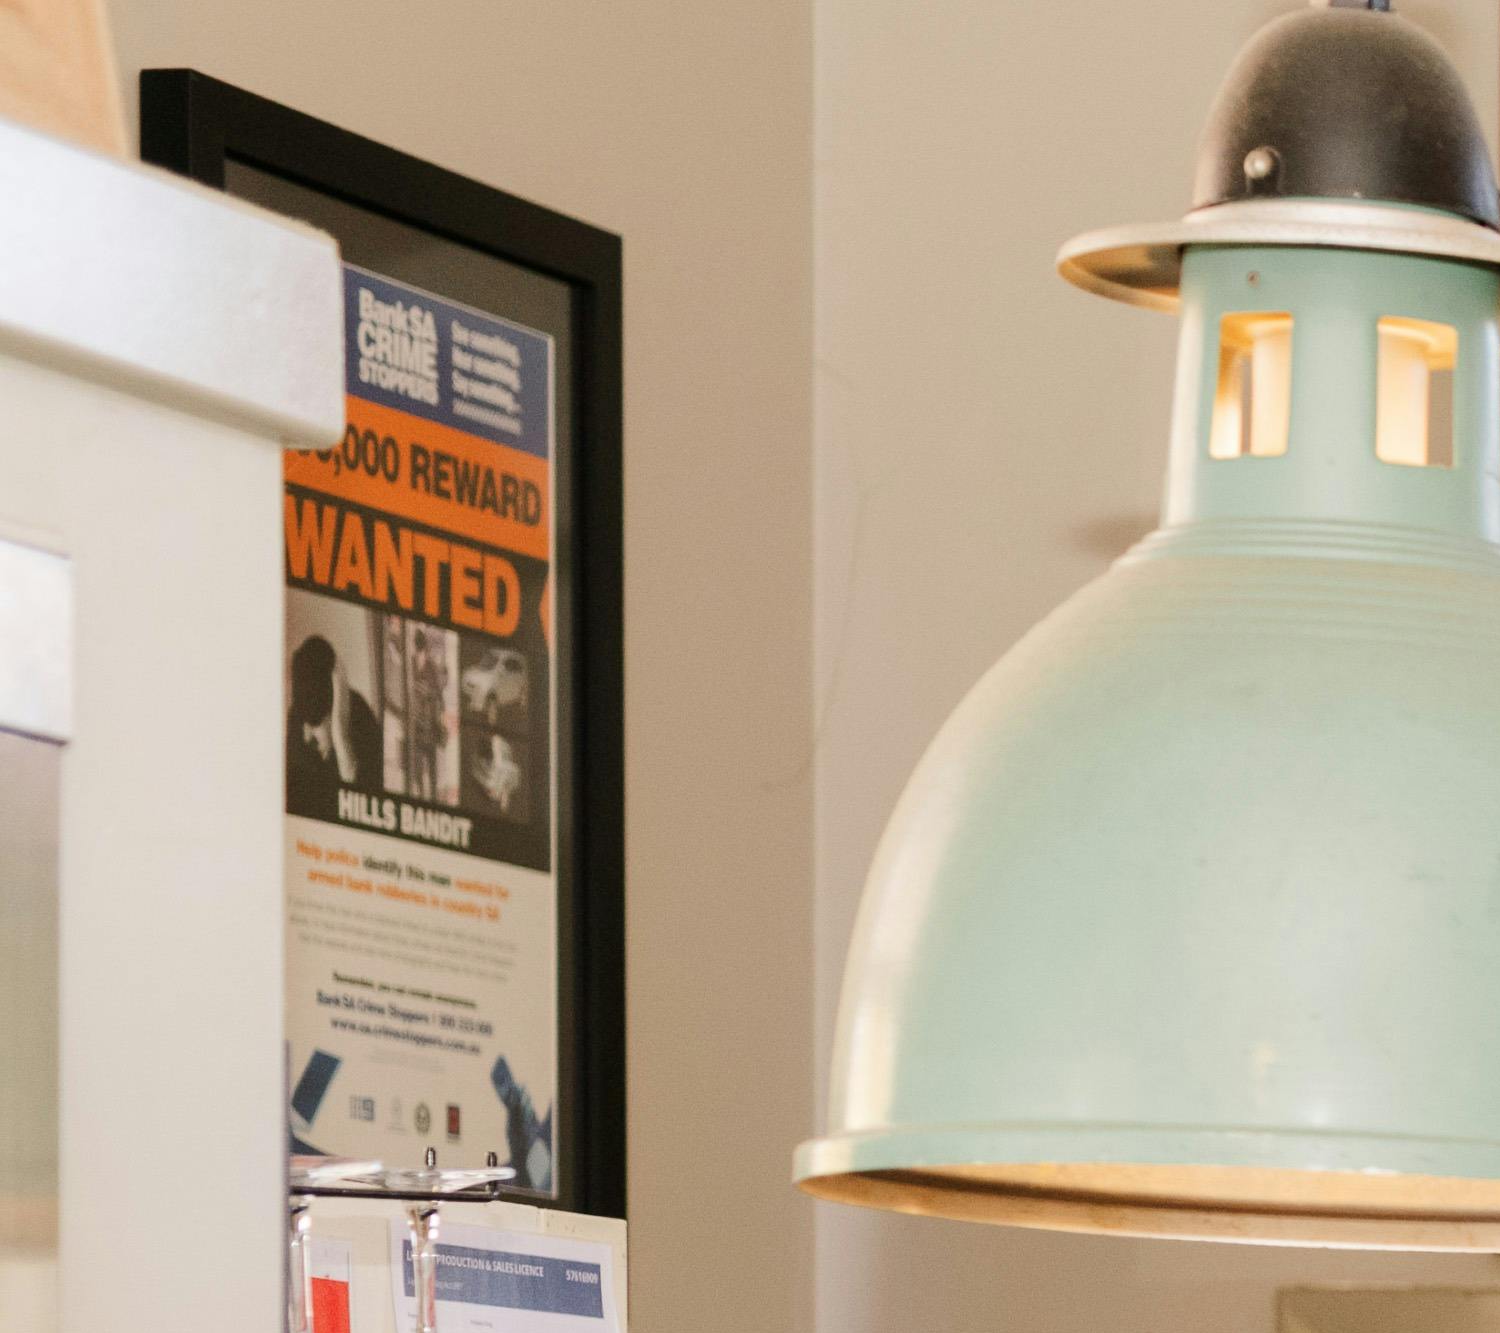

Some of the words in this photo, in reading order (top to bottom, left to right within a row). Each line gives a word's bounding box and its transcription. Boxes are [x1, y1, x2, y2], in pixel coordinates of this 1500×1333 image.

[357, 320, 437, 374] CRIME
[358, 356, 439, 407] STOPPERS
[408, 442, 542, 527] REWARD
[284, 491, 521, 638] WANTED
[338, 788, 397, 831] HILLS
[400, 802, 473, 849] BANDIT
[436, 1254, 485, 1270] PRODUCTION
[492, 1259, 515, 1274] SALES
[514, 1262, 545, 1279] LICENCE
